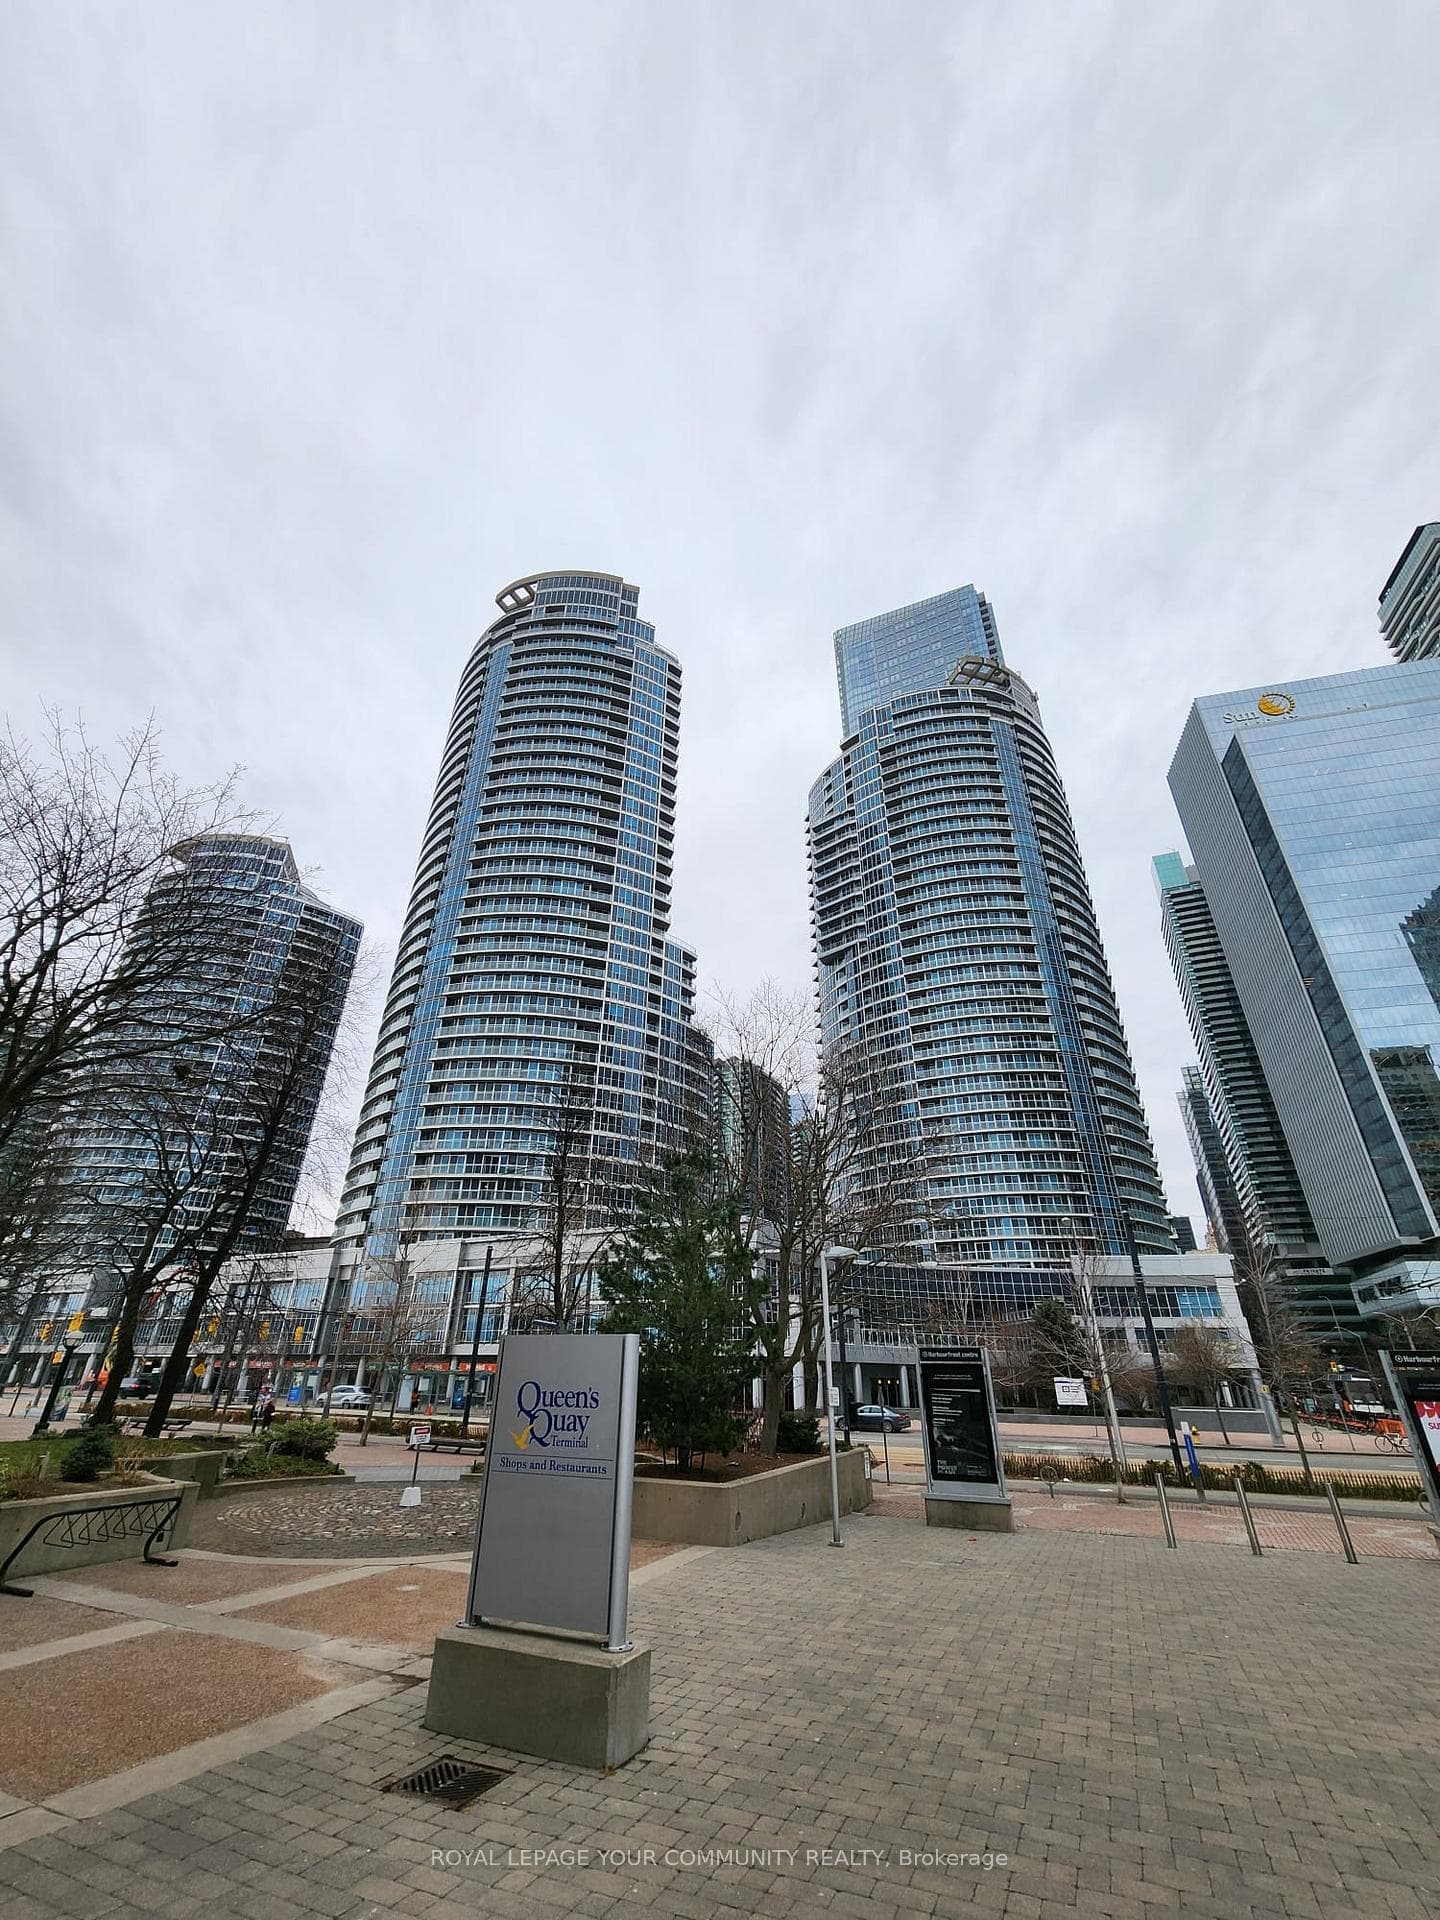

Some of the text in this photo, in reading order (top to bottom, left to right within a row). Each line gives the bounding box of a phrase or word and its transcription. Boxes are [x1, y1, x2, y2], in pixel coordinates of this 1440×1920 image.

[1223, 711, 1260, 724] Sun
[517, 1381, 599, 1419] Queen's
[529, 1408, 591, 1447] Quay
[550, 1435, 589, 1449] Terminal
[499, 1456, 607, 1475] Shops and Restaurants
